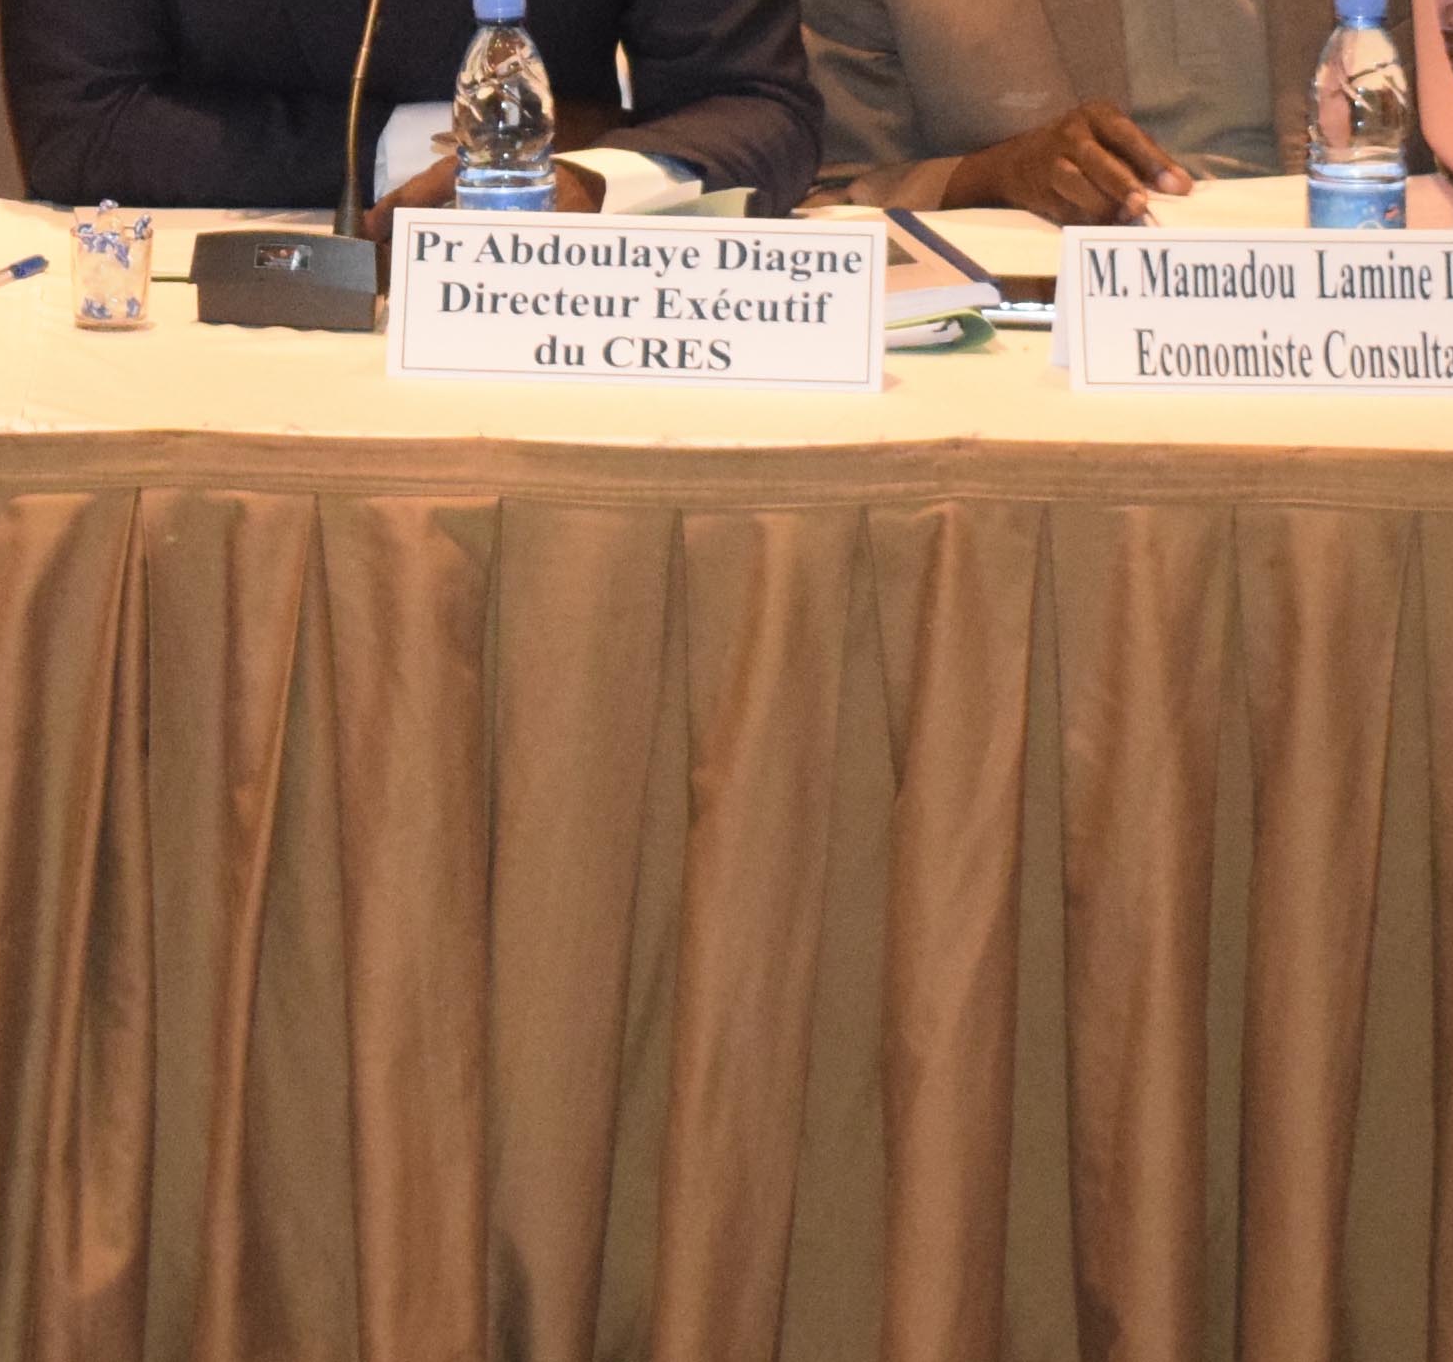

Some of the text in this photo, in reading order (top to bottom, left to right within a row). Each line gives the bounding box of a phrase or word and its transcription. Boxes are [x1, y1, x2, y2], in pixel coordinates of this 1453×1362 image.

[415, 230, 863, 282] Pr Abdoulaye Diagne
[1087, 247, 1130, 298] M.
[1139, 247, 1297, 300] Mamadou
[1316, 249, 1434, 302] Lamine
[440, 280, 834, 325] Directeur Exécutif
[533, 334, 733, 370] du CRES
[1134, 327, 1314, 380] Economiste
